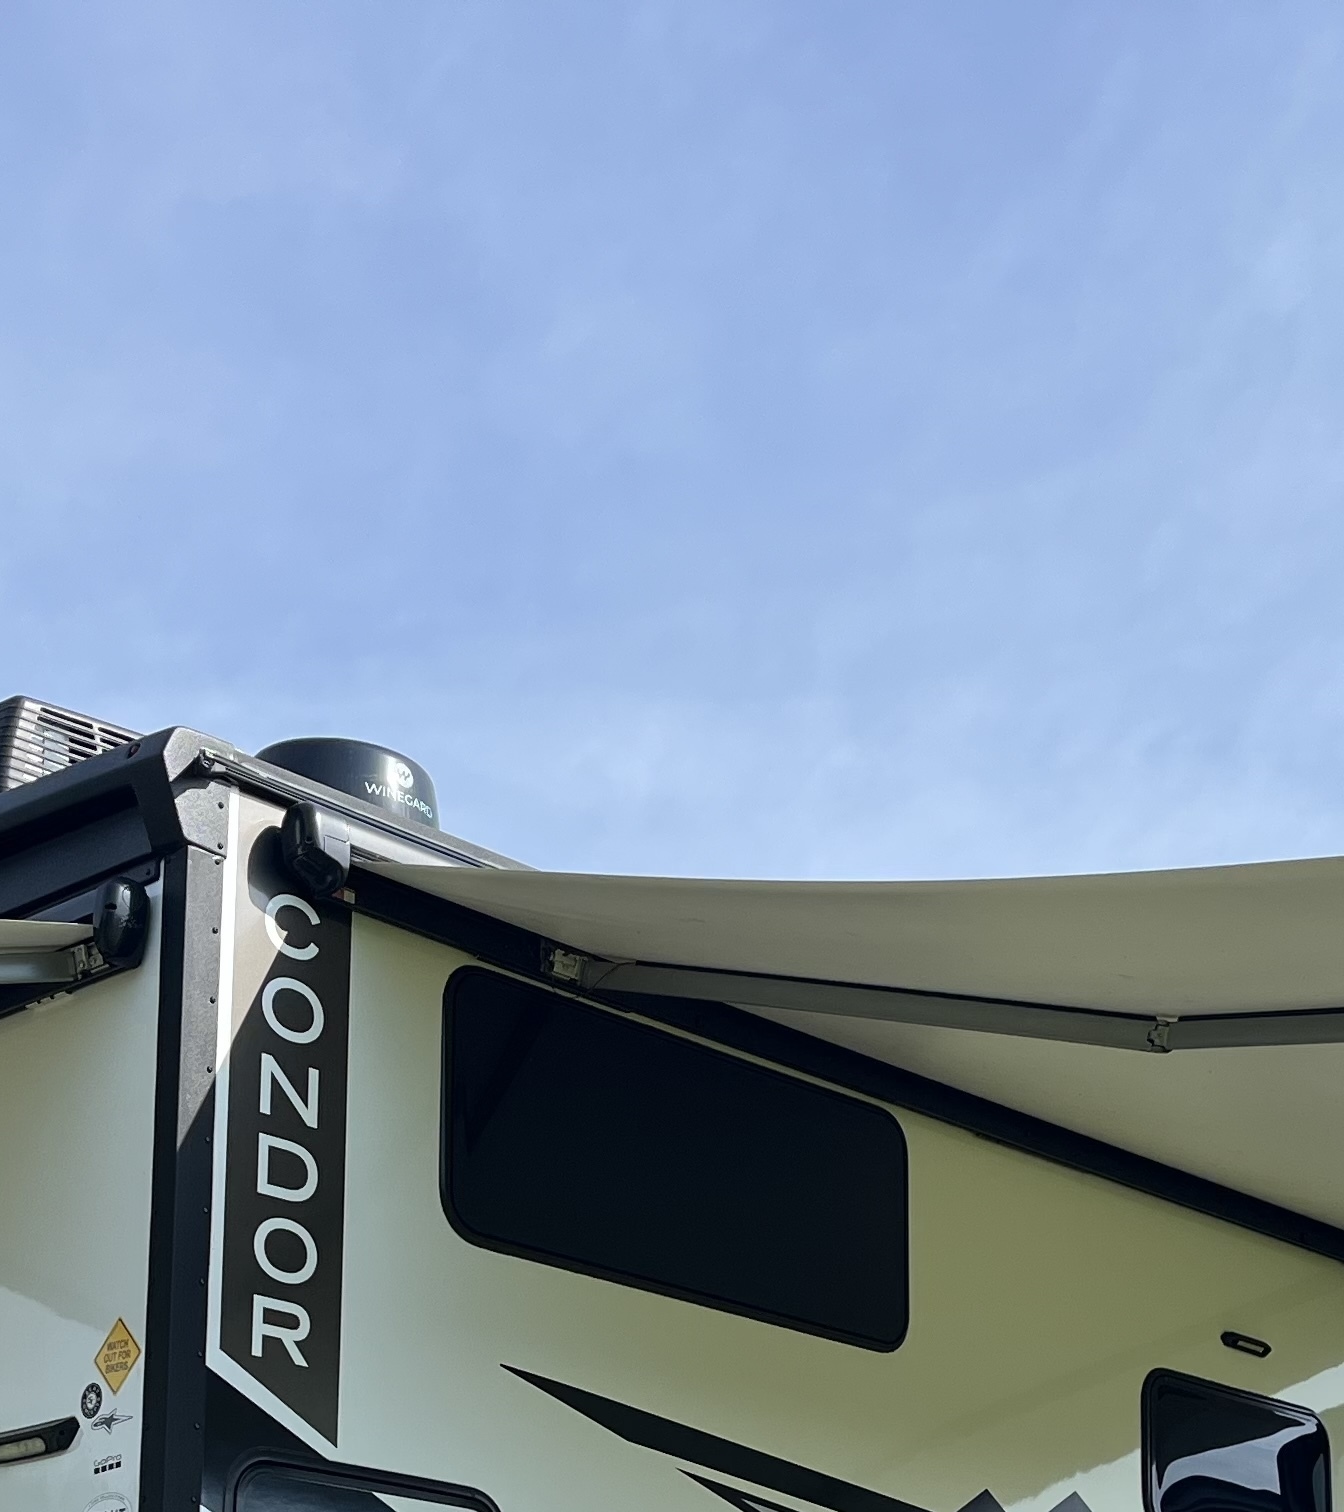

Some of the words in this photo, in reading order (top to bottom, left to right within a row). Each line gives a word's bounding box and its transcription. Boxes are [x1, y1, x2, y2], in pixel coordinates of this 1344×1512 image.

[364, 781, 433, 819] WINEGARD
[250, 893, 325, 1369] CONDOR
[107, 1340, 129, 1352] WATCH
[103, 1351, 118, 1364] OUT
[117, 1349, 132, 1361] FOR
[105, 1361, 129, 1374] BIKERS
[93, 1454, 122, 1468] GoPro
